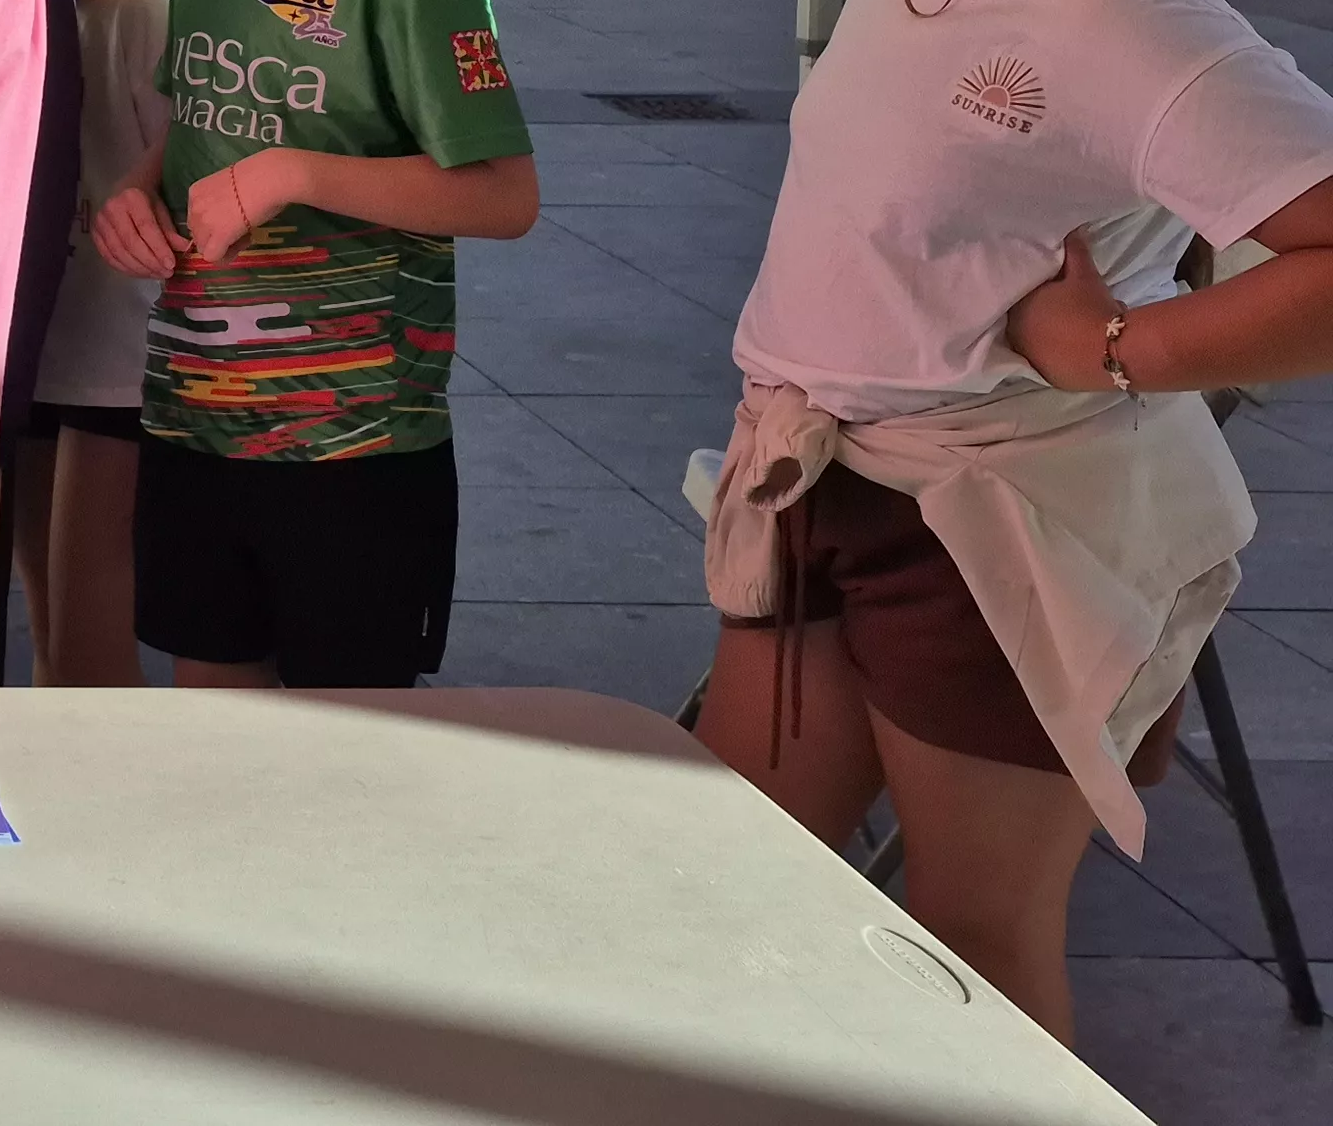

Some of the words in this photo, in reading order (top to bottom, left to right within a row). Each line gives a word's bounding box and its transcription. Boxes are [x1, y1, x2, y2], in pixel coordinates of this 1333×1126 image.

[294, 8, 335, 36] 25
[314, 35, 339, 48] AÑOS
[951, 93, 1034, 134] SUNRISE
